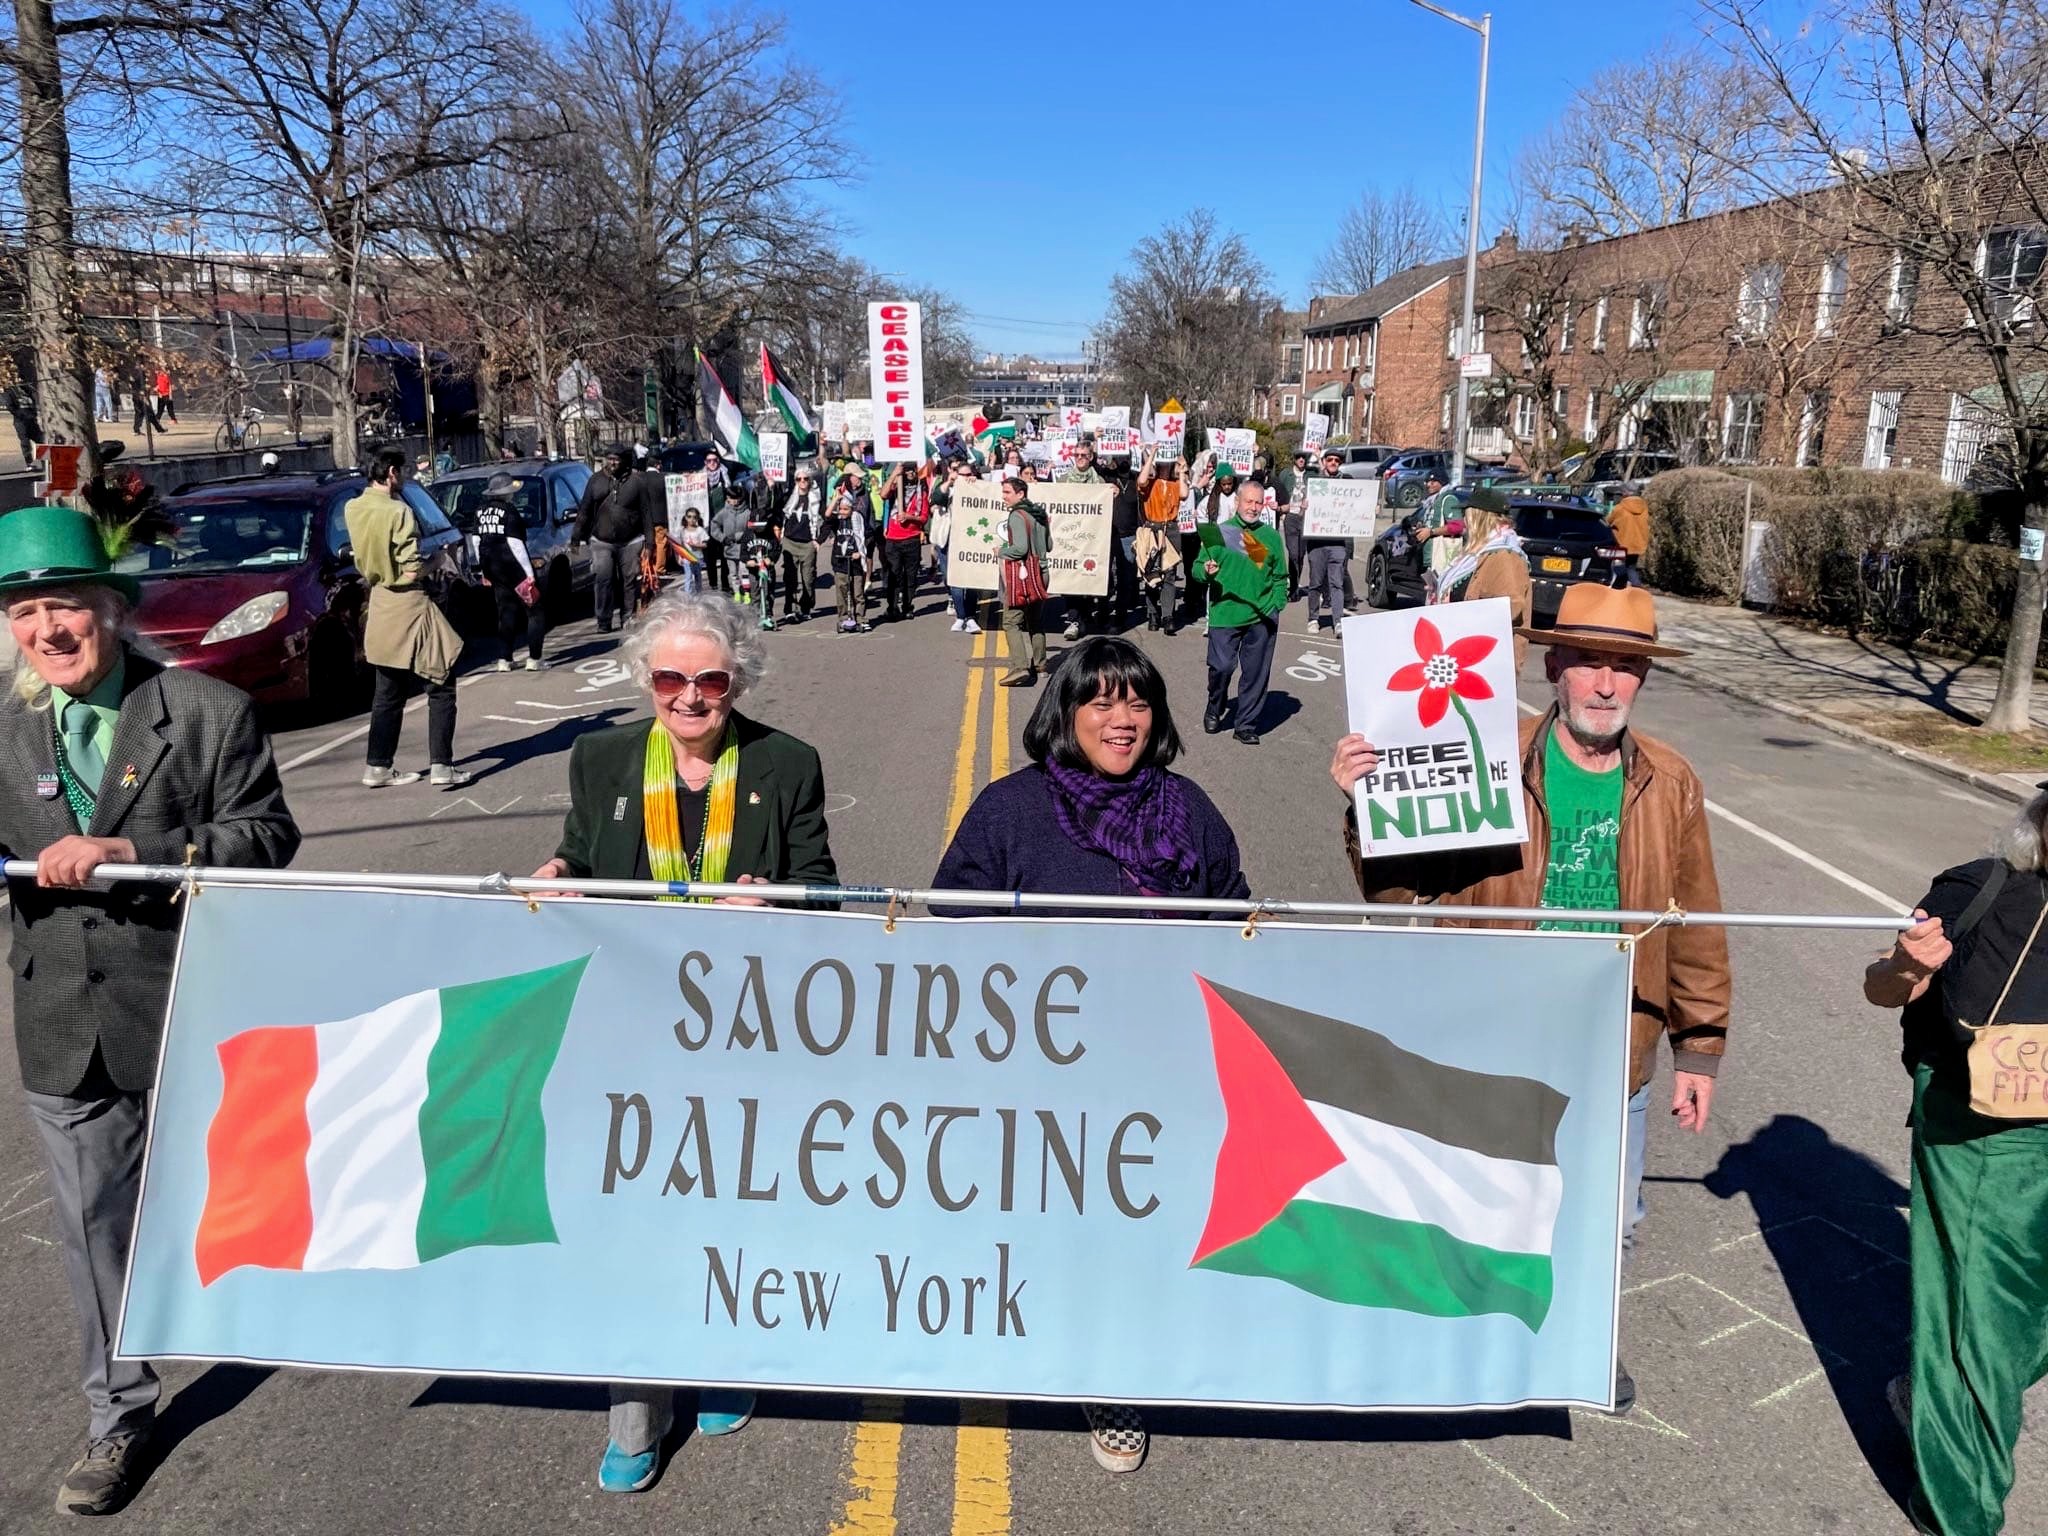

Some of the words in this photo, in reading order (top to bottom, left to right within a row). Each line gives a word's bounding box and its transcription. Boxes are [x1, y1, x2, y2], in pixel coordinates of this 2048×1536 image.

[880, 305, 909, 384] CEASE
[886, 391, 912, 448] FIRE
[1226, 448, 1251, 456] CEASE
[1226, 455, 1251, 463] FIRE
[479, 515, 500, 525] OUR
[961, 496, 989, 510] FROM
[1050, 503, 1103, 515] PALESTINE
[958, 550, 999, 565] OCCUPA
[1372, 741, 1468, 768] FREE
[1368, 787, 1515, 840] NOW
[673, 950, 1089, 1066] SAOIRSE
[602, 1092, 1163, 1219] PALESTINE
[703, 1245, 841, 1332] New
[875, 1242, 1028, 1338] York
